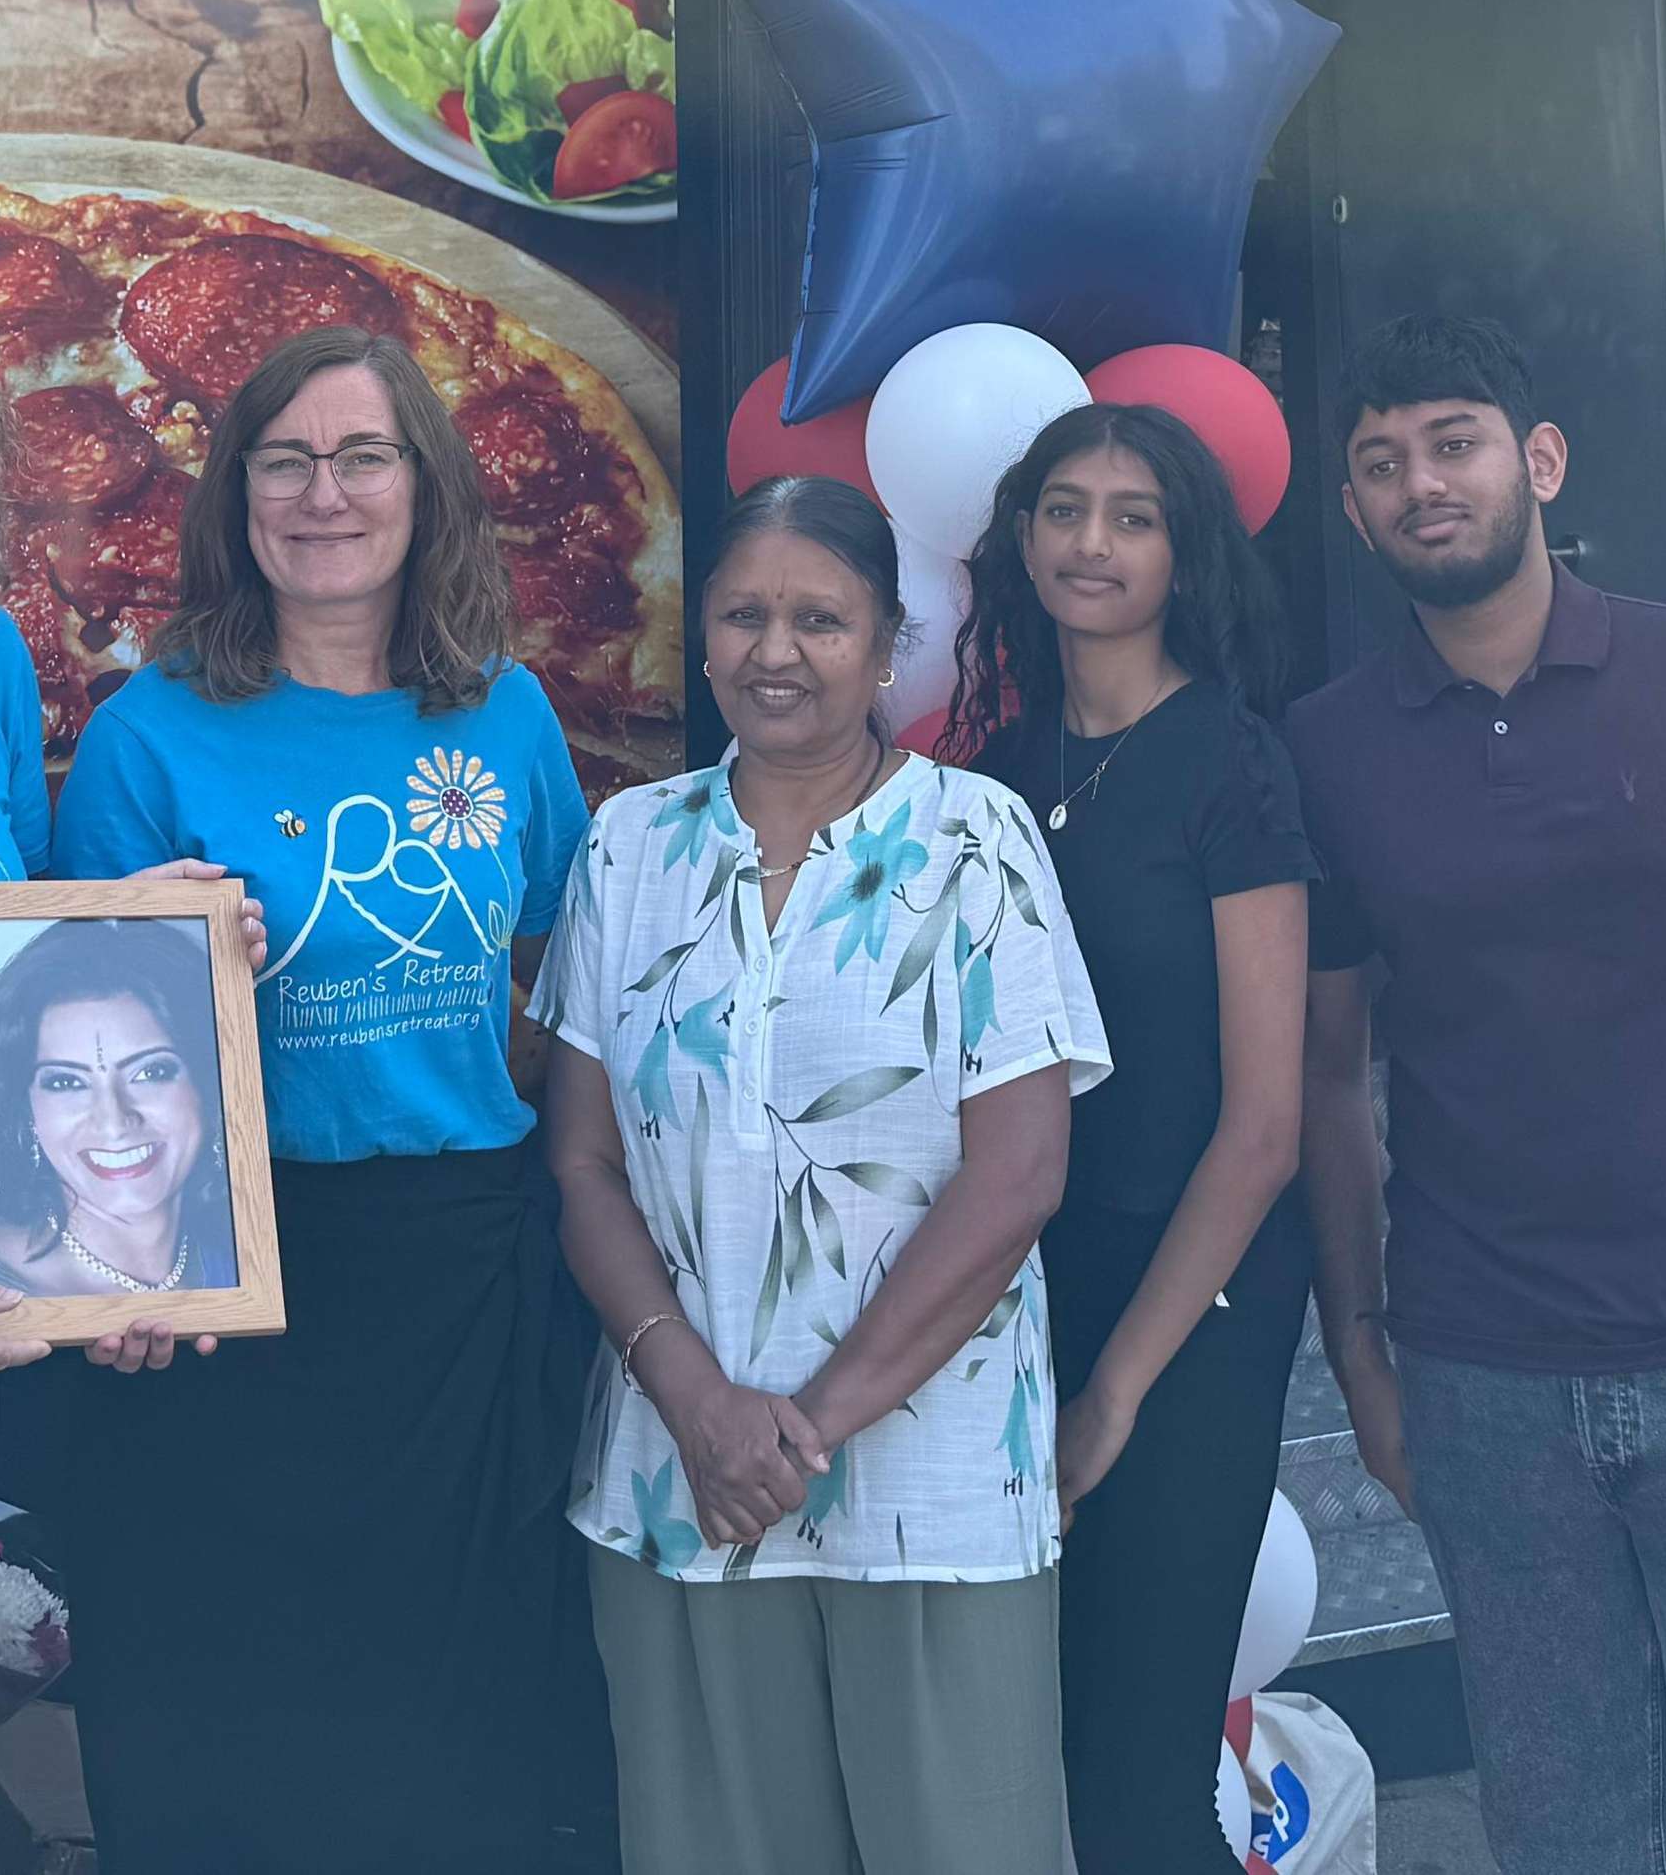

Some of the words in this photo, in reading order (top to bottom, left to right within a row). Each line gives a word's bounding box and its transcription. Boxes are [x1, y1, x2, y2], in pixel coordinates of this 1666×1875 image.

[278, 971, 387, 1005] Reuben's
[402, 958, 486, 989] Retreat
[277, 1010, 481, 1050] www.reubensretreat.org
